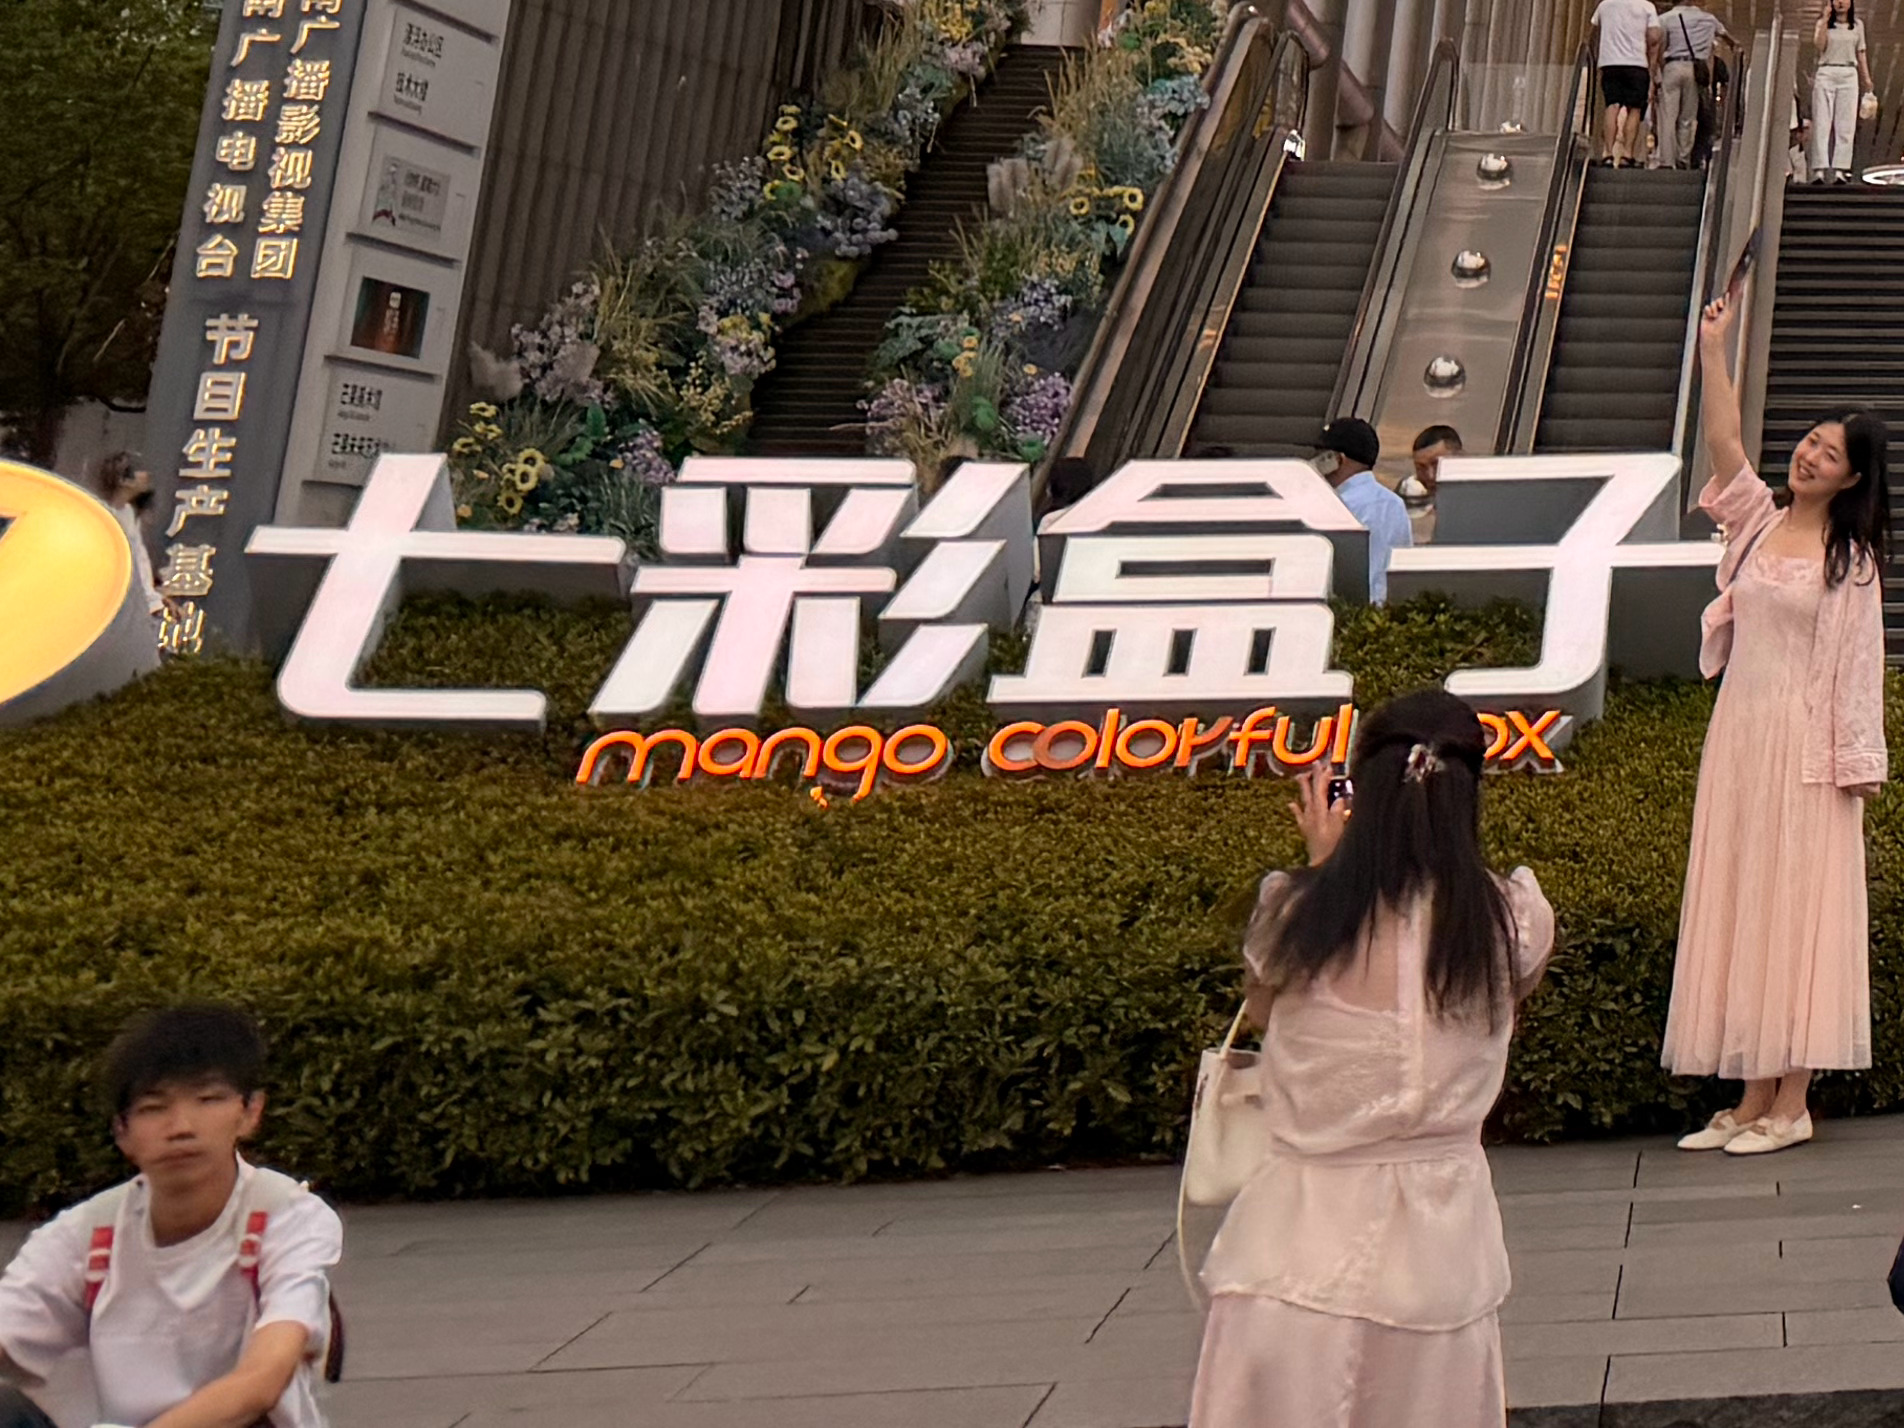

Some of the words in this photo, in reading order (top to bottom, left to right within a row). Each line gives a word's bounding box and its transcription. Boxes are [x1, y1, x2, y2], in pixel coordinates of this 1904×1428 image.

[244, 452, 1727, 721] 七彩盒子
[575, 723, 949, 806] mango
[988, 702, 1355, 772] colorful
